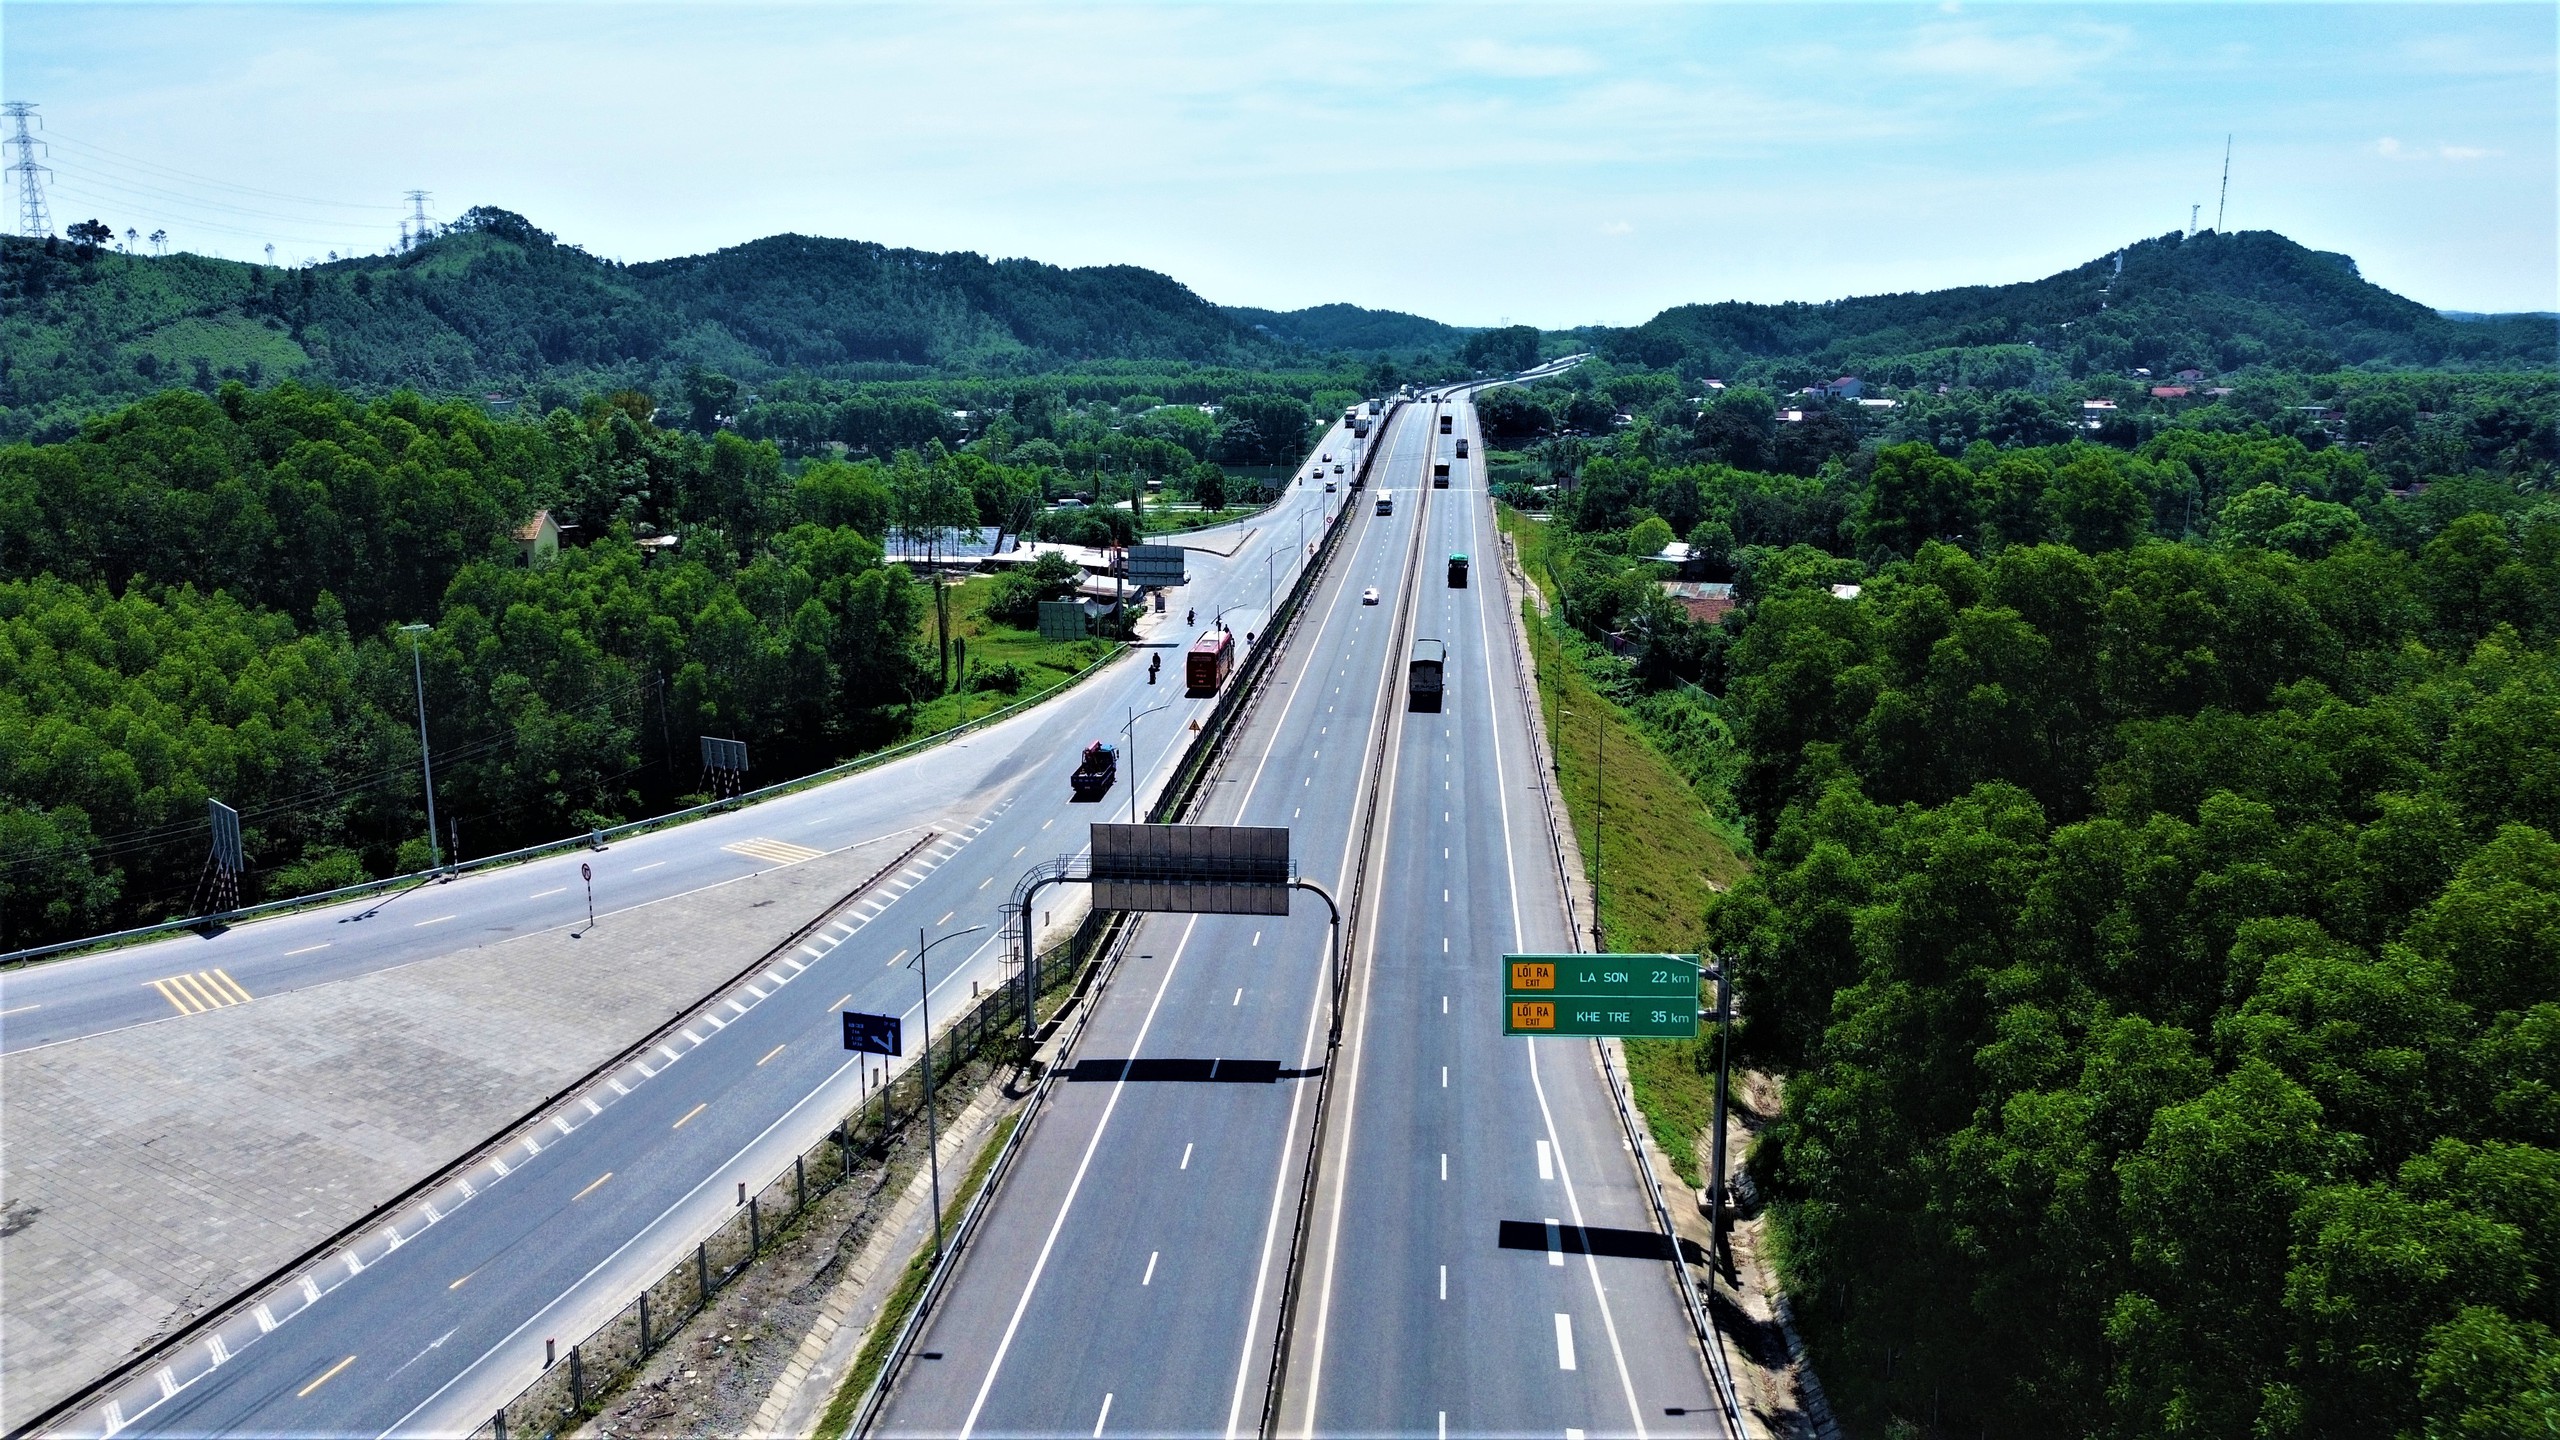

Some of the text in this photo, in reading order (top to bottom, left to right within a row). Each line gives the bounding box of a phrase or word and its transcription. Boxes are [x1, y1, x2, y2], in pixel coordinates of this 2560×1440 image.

[1517, 963, 1550, 978] LỐI RA
[1526, 979, 1540, 987] EXIT
[1580, 971, 1690, 984] LA SƠN 22 km
[1517, 1003, 1550, 1017] LỐI RA
[1526, 1018, 1540, 1027] EXIT
[1577, 1011, 1690, 1024] KHE TRE 35 km
